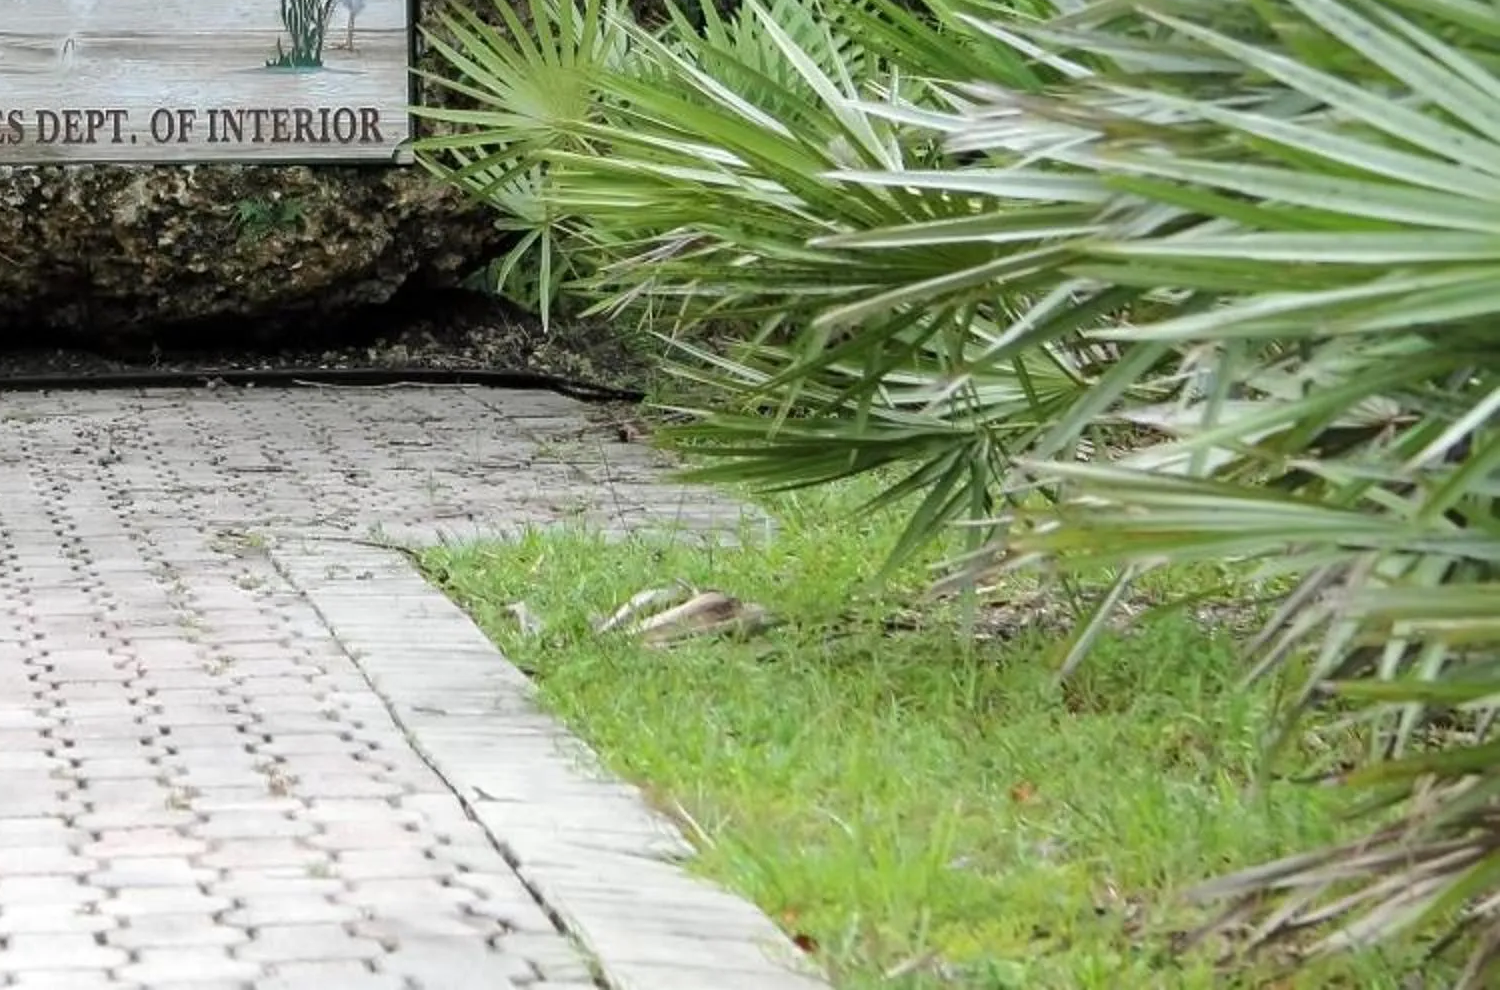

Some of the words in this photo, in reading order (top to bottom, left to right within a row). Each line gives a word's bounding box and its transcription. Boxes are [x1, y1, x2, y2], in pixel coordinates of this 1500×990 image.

[34, 108, 138, 146] DEPT.
[149, 108, 197, 145] OF
[206, 107, 384, 145] INTERIOR
